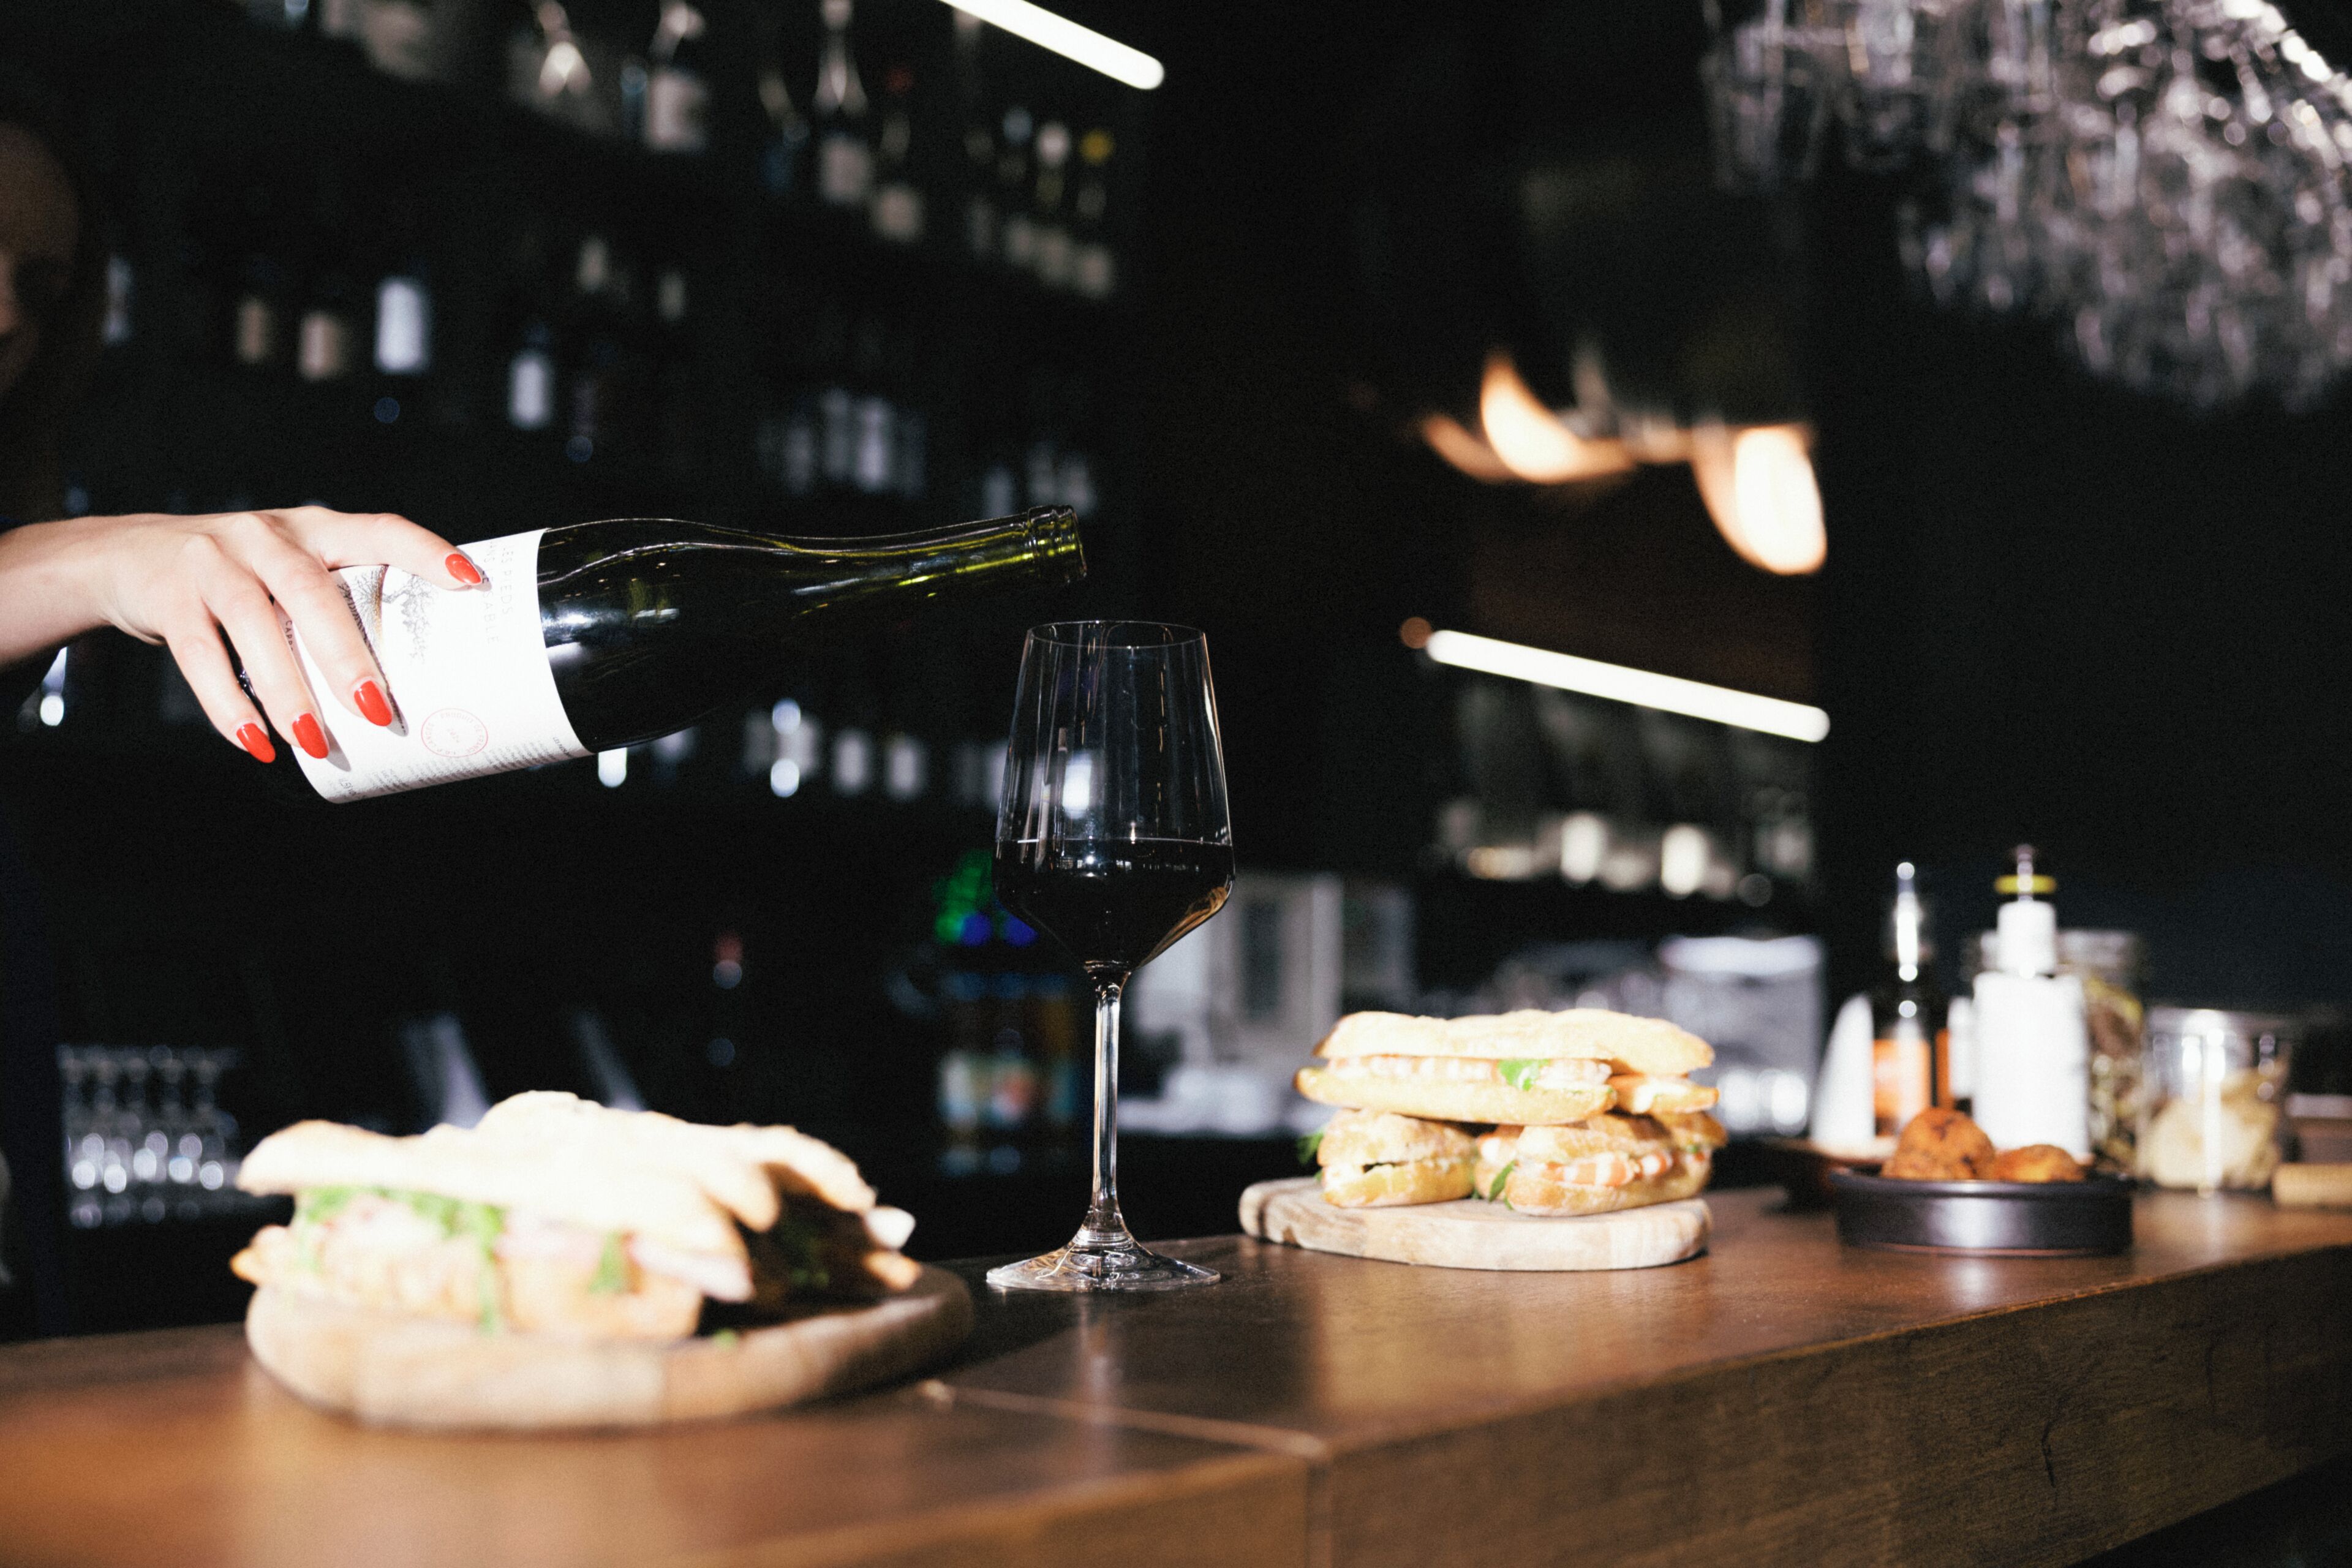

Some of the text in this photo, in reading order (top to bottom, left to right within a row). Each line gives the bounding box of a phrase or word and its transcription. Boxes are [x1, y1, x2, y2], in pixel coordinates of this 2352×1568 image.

[499, 546, 514, 616] LES PIEDS
[482, 590, 500, 645] SABLE
[466, 735, 484, 753] FRANCE
